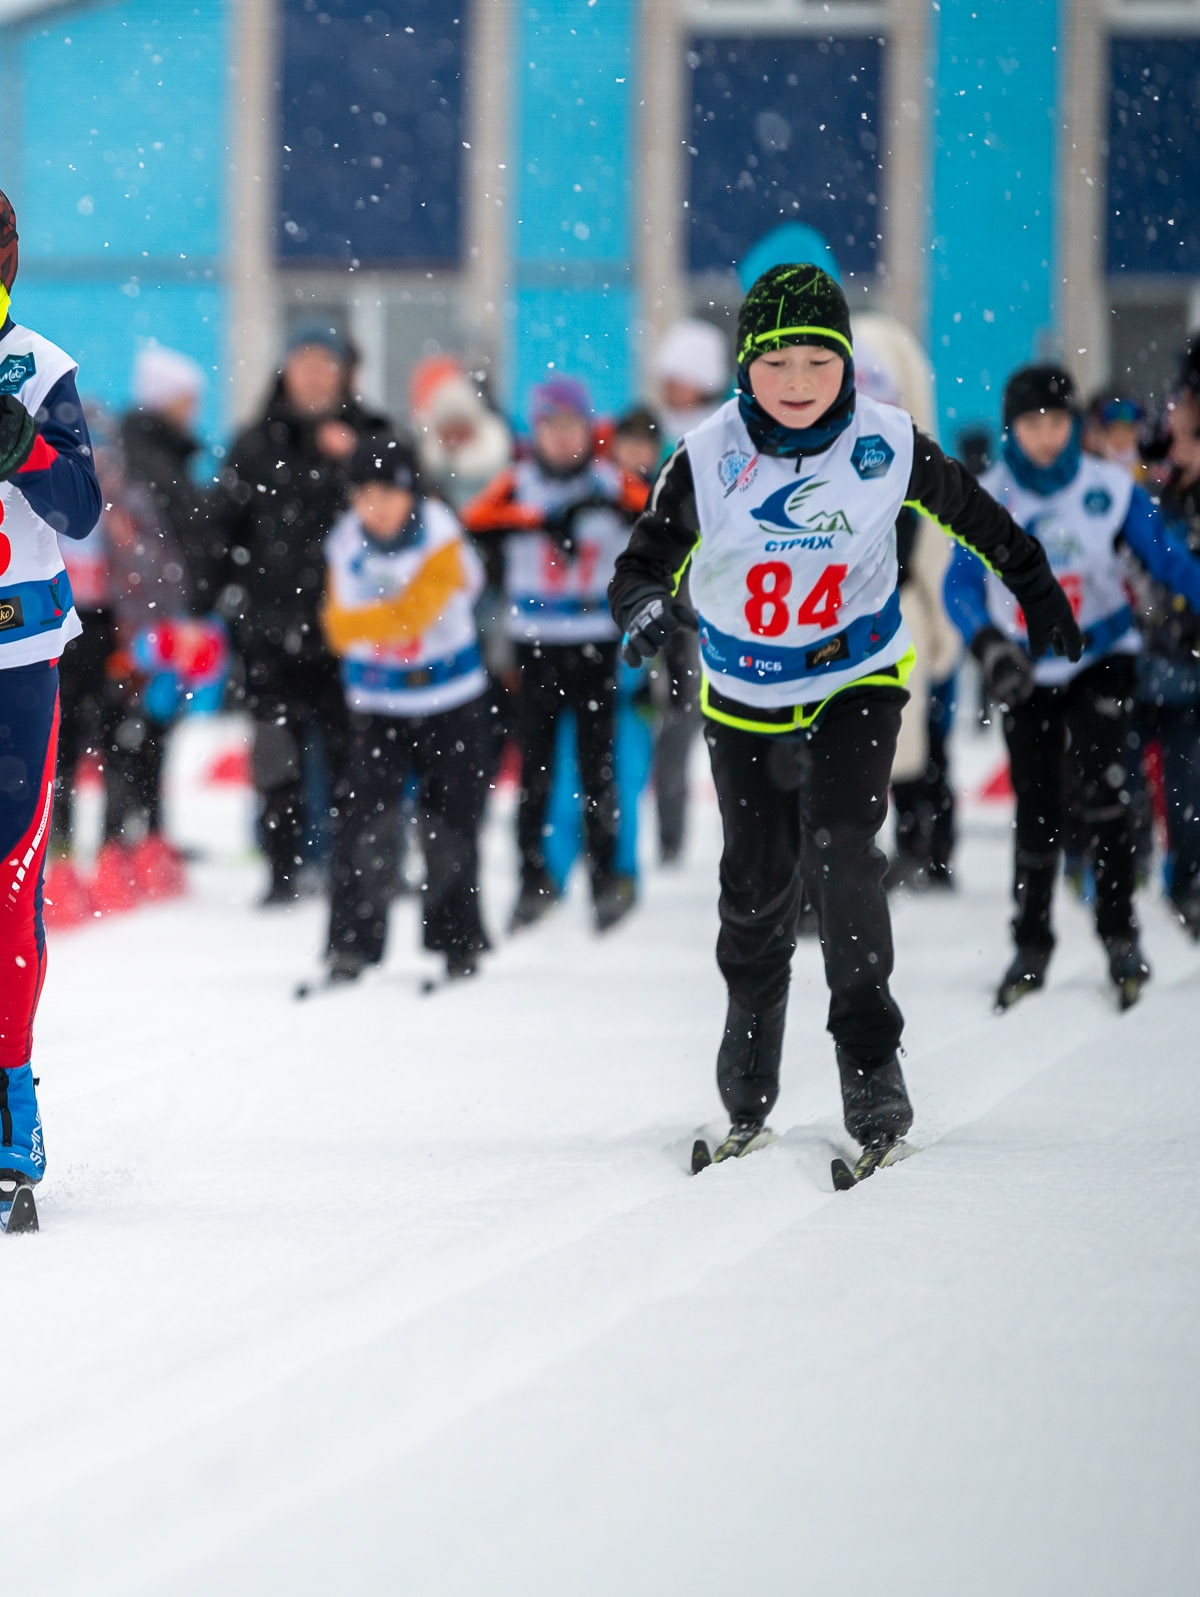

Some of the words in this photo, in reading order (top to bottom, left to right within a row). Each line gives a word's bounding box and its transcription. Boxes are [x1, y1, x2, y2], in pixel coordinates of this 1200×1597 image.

[764, 534, 835, 552] СТРИЖ
[744, 560, 849, 638] 84
[755, 659, 783, 672] ПСБ
